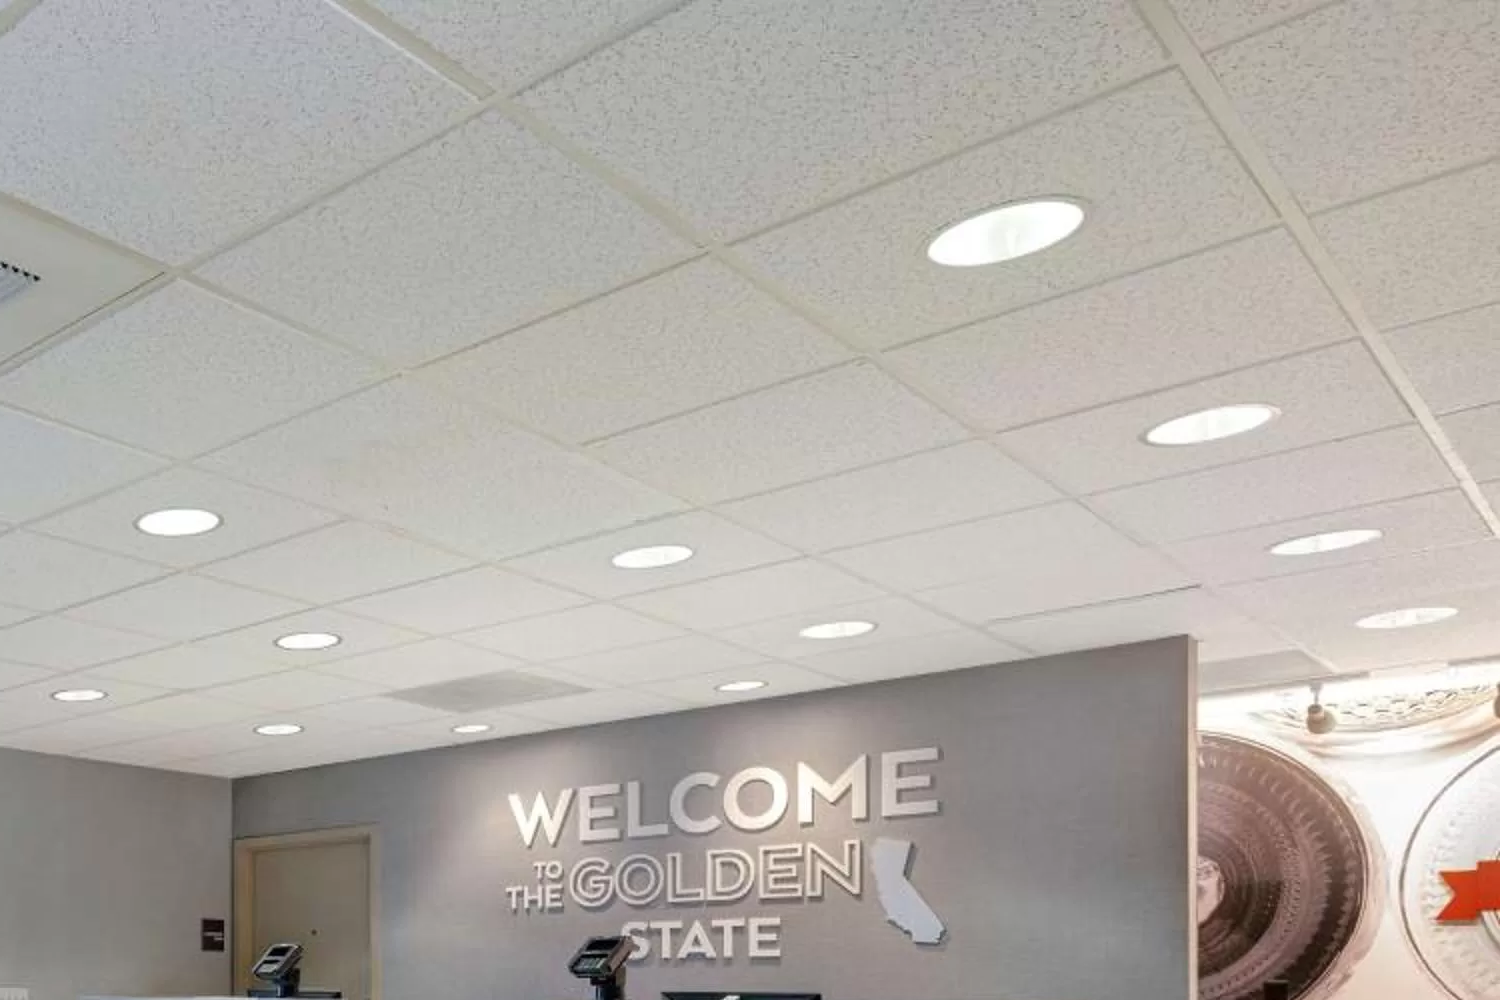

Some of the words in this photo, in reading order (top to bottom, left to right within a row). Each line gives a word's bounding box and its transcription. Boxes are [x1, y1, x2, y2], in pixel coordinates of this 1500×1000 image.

[508, 747, 939, 847] WELCOME
[505, 884, 563, 910] THE
[569, 839, 862, 907] GOLDEN
[533, 860, 563, 880] TO
[622, 917, 781, 960] STATE
